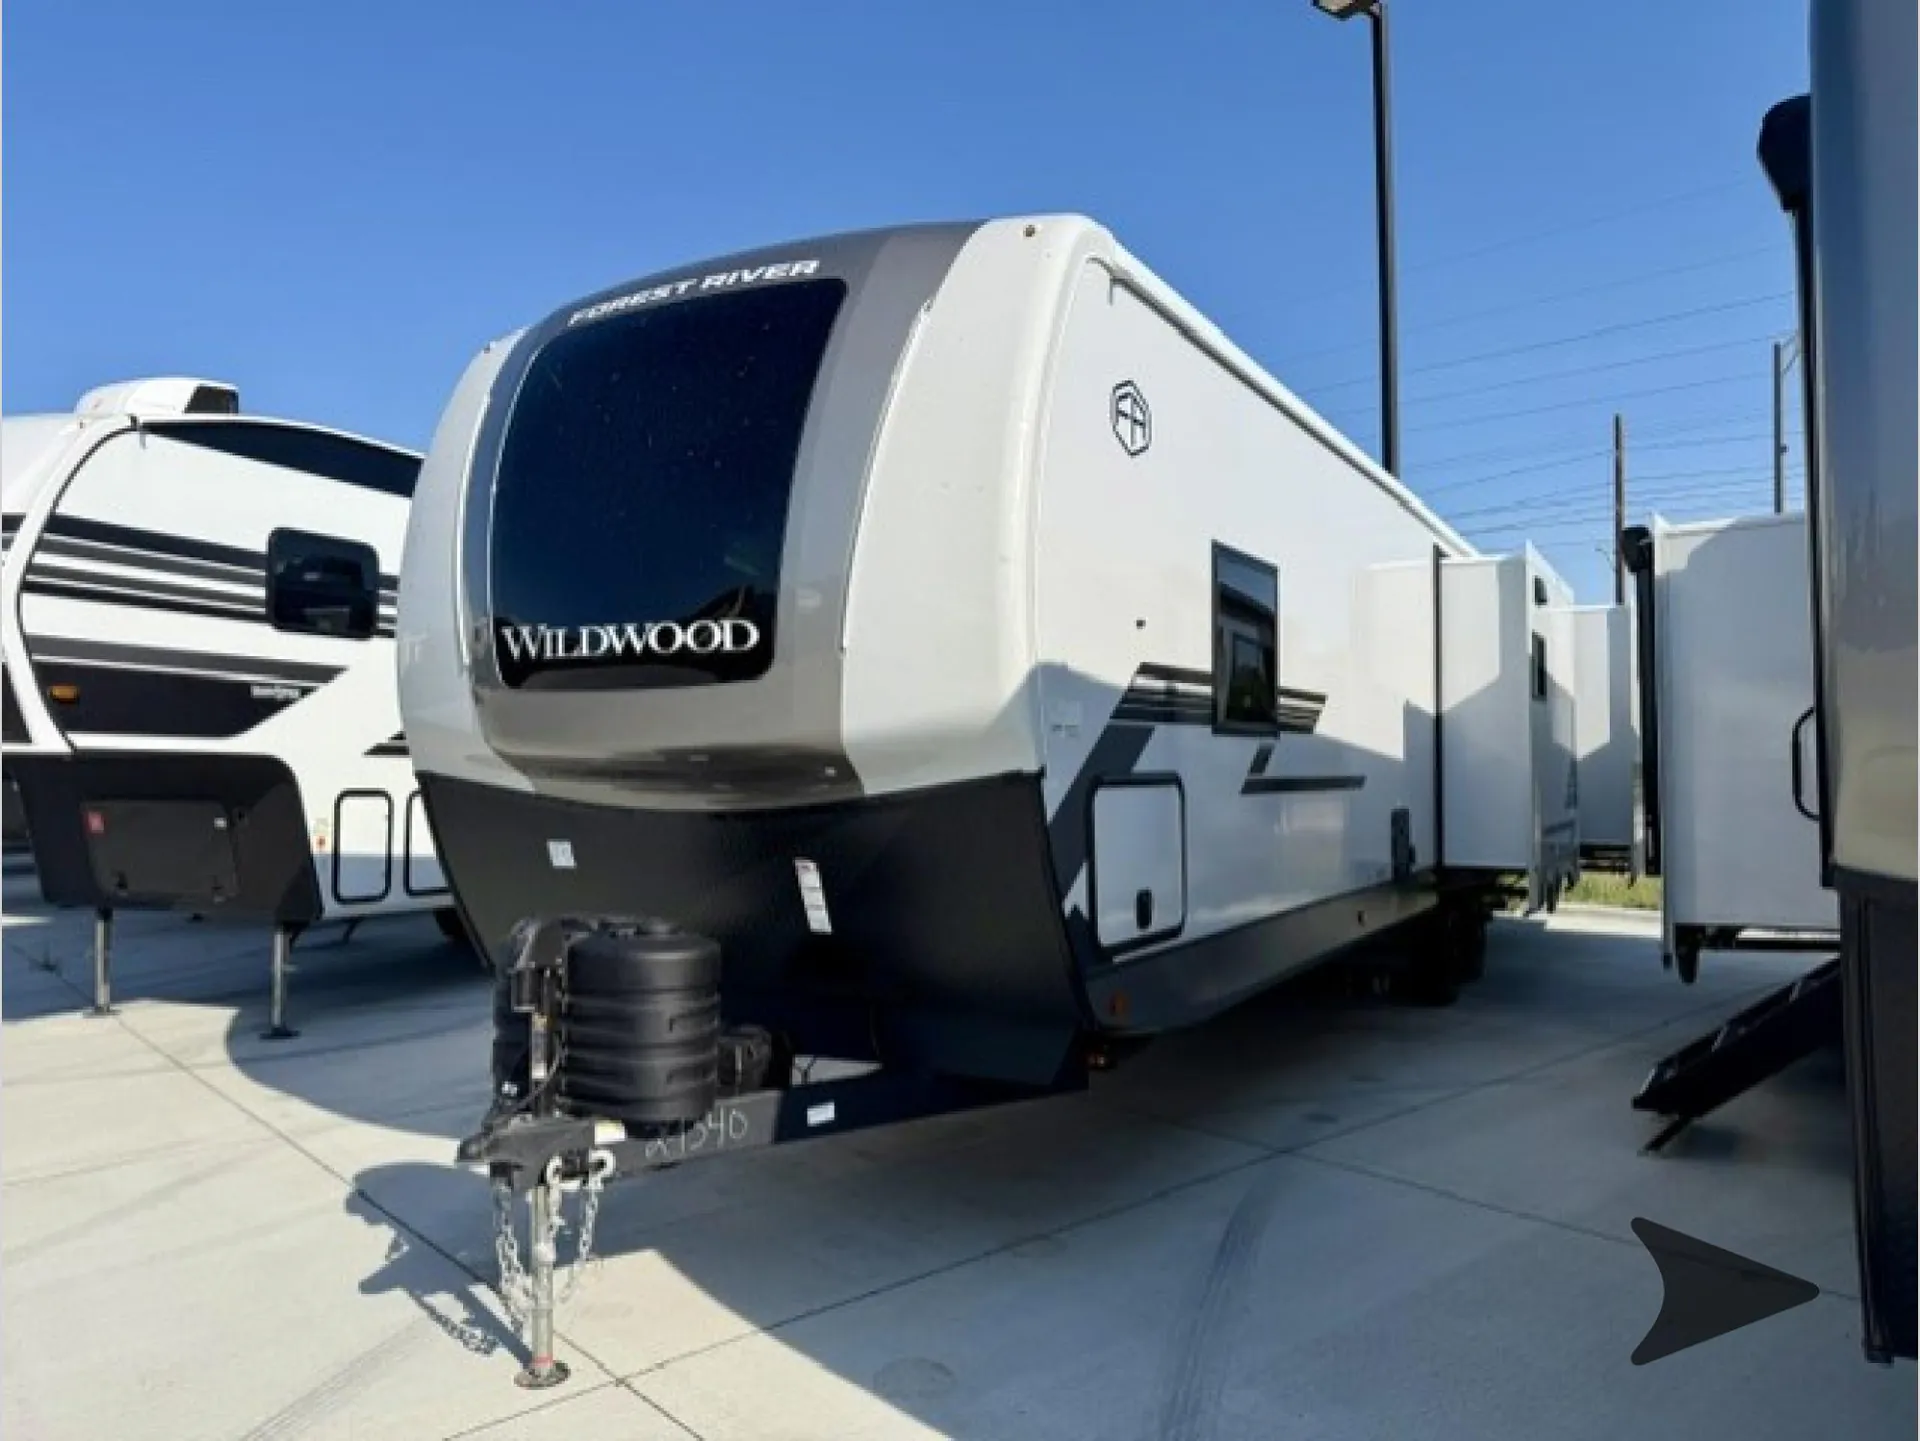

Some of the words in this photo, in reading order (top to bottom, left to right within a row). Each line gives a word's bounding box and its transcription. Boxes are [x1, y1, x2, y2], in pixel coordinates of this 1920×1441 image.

[567, 278, 698, 327] FOREST
[700, 259, 820, 290] RIVER
[501, 619, 761, 660] WILDWOOD
